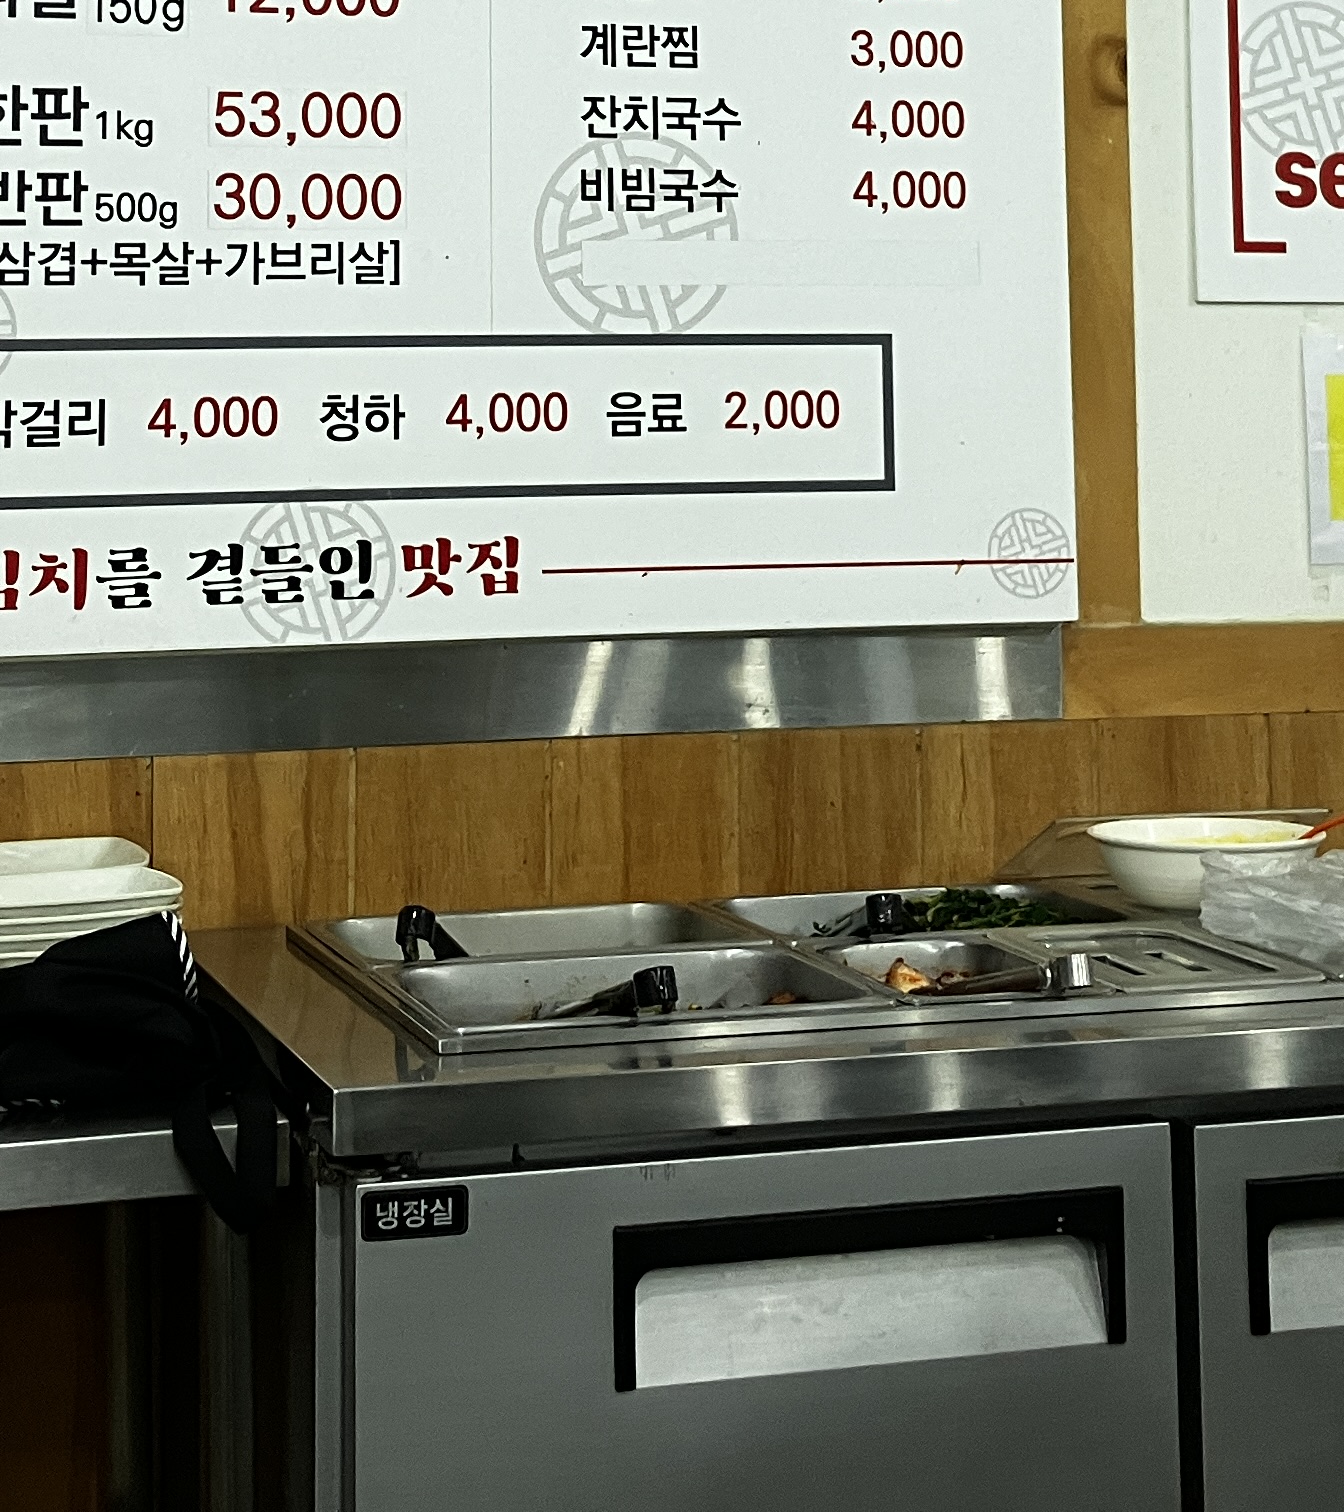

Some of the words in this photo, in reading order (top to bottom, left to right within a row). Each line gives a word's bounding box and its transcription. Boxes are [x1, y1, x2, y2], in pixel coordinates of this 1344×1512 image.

[579, 23, 699, 69] 계란찜
[850, 29, 964, 74] 3,000
[95, 109, 154, 148] 1kg
[214, 90, 402, 147] 53,000
[580, 94, 742, 142] 잔치국수
[851, 99, 965, 144] 4,000
[95, 191, 178, 230] 500g
[213, 172, 402, 229] 30,000
[580, 167, 739, 213] 비빔국수
[852, 170, 966, 215] 4,000
[147, 395, 278, 446] 4,000
[319, 393, 406, 442] 청하
[445, 391, 568, 440] 4,000
[606, 391, 688, 438] 음료
[724, 389, 840, 436] 2,000
[186, 539, 375, 606] 곁들인
[400, 535, 519, 599] 맛집
[375, 1196, 454, 1231] 냉장실
